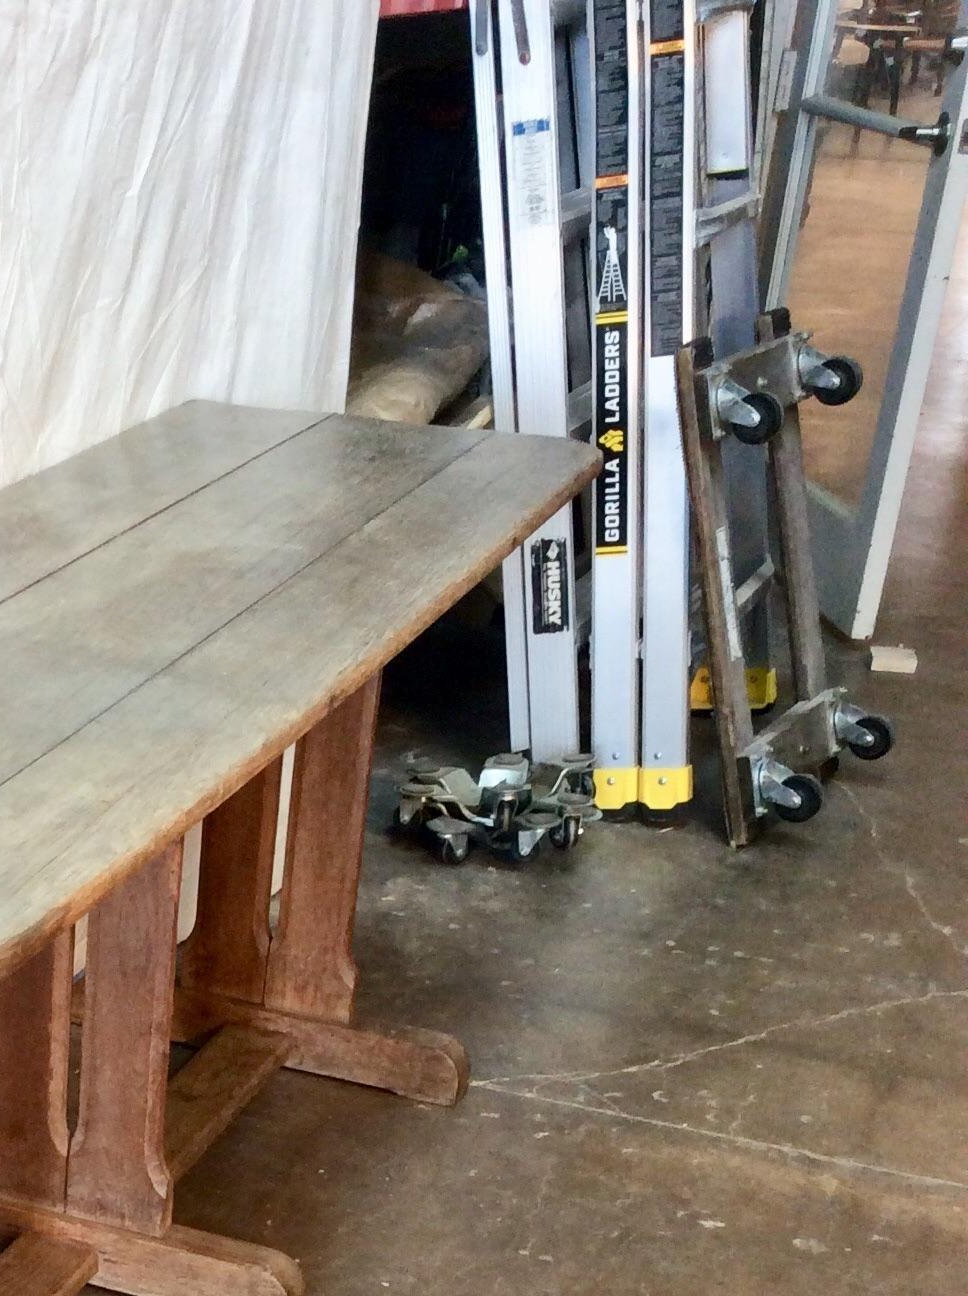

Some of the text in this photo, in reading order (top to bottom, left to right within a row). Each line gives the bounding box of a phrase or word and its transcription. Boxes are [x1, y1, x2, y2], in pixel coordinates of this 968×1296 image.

[604, 330, 620, 422] LADDERS
[604, 459, 620, 543] GORILLA
[547, 561, 562, 625] HUSKY
